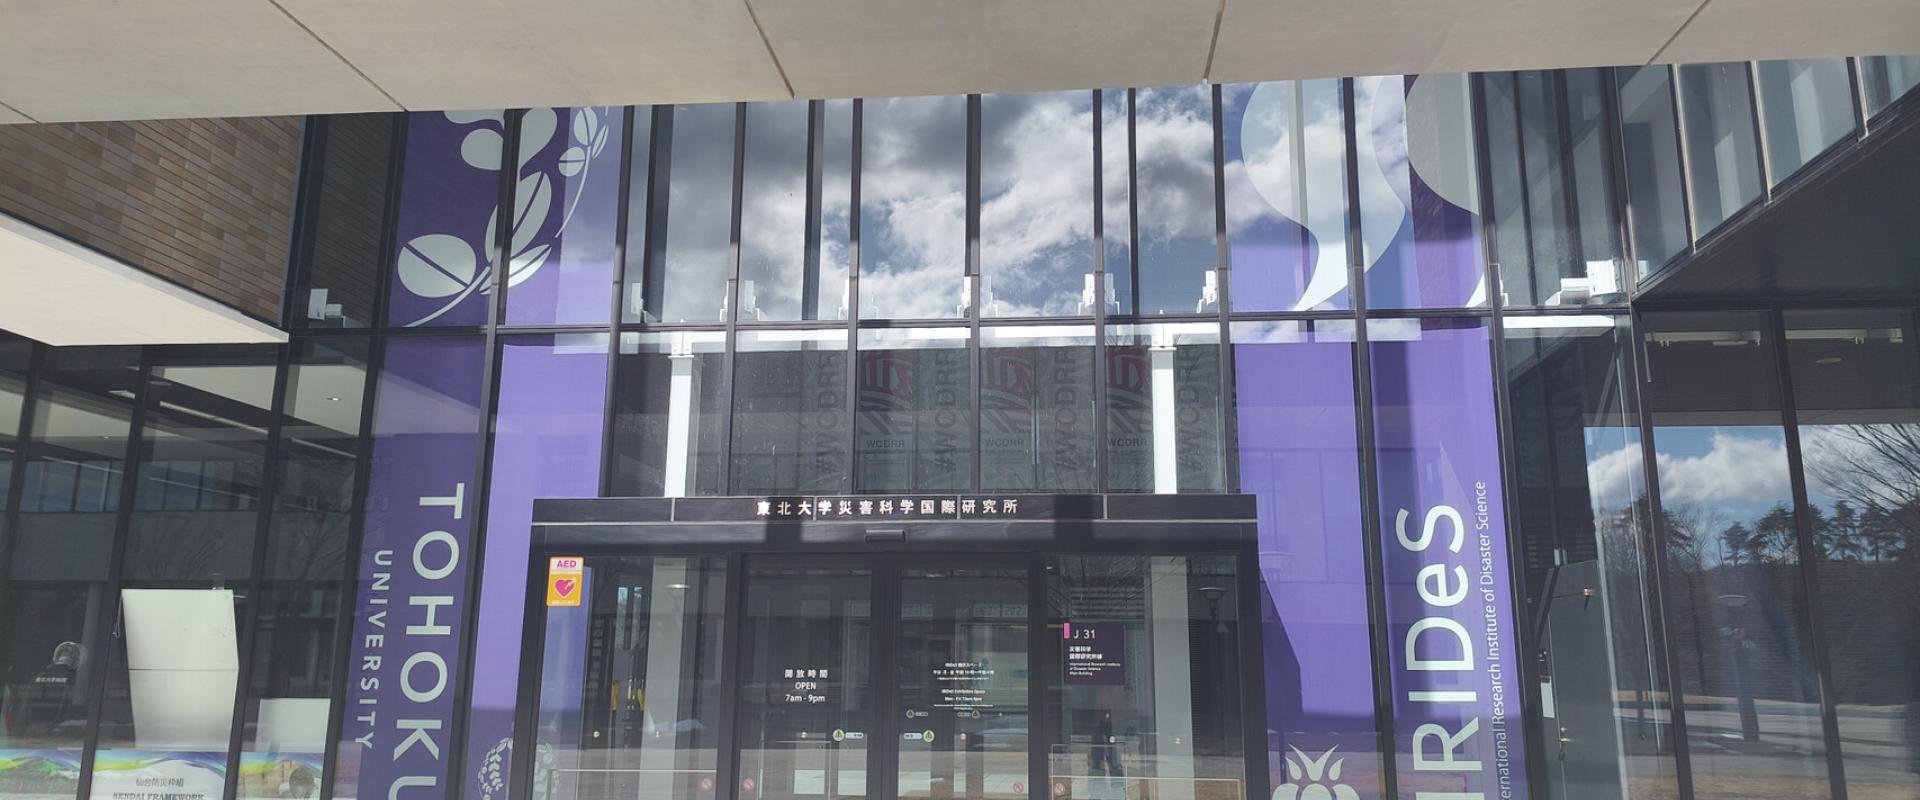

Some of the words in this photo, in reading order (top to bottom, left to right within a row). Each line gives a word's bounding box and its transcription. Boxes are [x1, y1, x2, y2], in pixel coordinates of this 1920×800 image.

[866, 439, 905, 449] WCDRR
[984, 438, 1025, 448] WCDRR
[1106, 438, 1147, 448] WCDRR
[757, 499, 1018, 516] 東北大学災害科学国際研究所
[1475, 481, 1489, 530] Science
[557, 559, 577, 568] AED
[1479, 534, 1494, 585] Disaster
[1480, 588, 1495, 602] of
[1073, 629, 1079, 639] J
[1083, 629, 1095, 639] 31
[1484, 604, 1500, 660] Institute
[388, 482, 465, 800] TOHOKU
[354, 549, 394, 750] UNIVERSITY
[1395, 504, 1486, 800] IRIDeS
[795, 681, 816, 690] OPEN
[785, 694, 803, 702] 7am
[808, 694, 826, 704] 9pm
[1487, 663, 1504, 725] Research
[1492, 728, 1512, 800] ernational
[147, 792, 204, 800] FRAMEWORK
